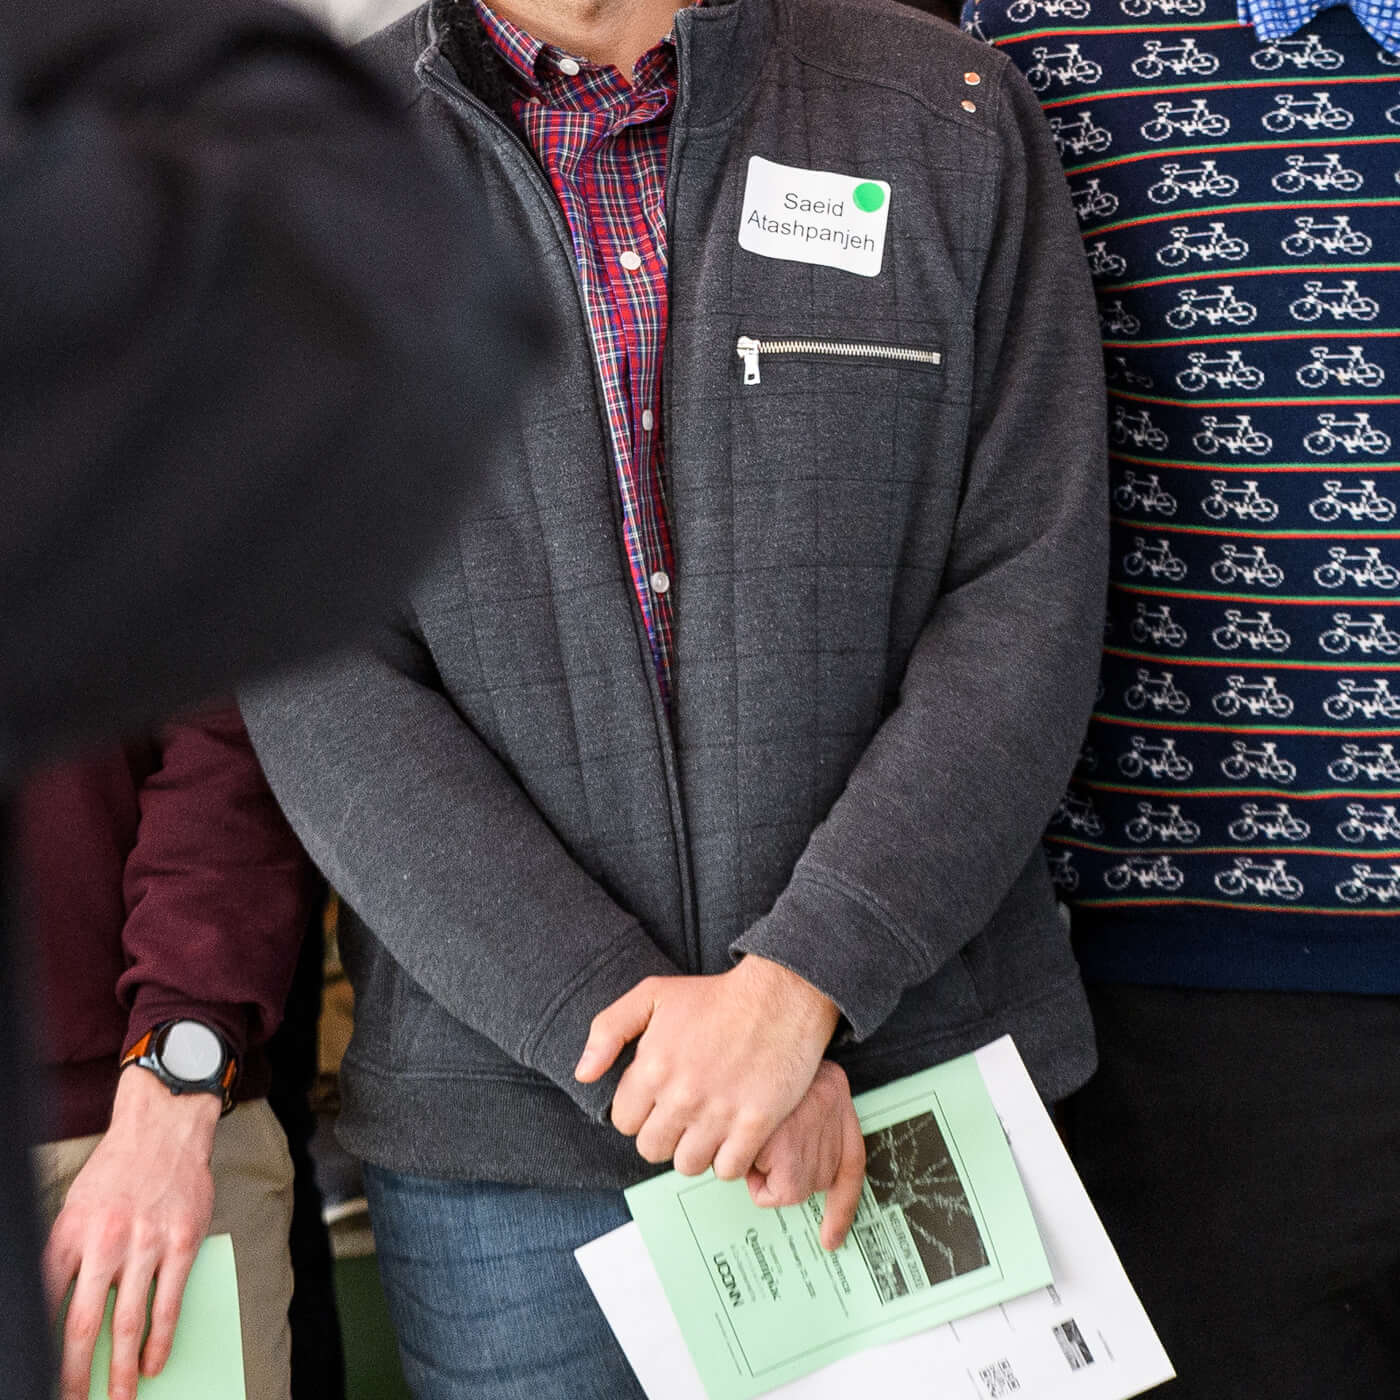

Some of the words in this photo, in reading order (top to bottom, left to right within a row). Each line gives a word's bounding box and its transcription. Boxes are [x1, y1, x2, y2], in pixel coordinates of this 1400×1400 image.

[784, 192, 844, 217] Saeid
[747, 209, 875, 252] Atashpanjeh
[711, 1250, 745, 1308] UCONN
